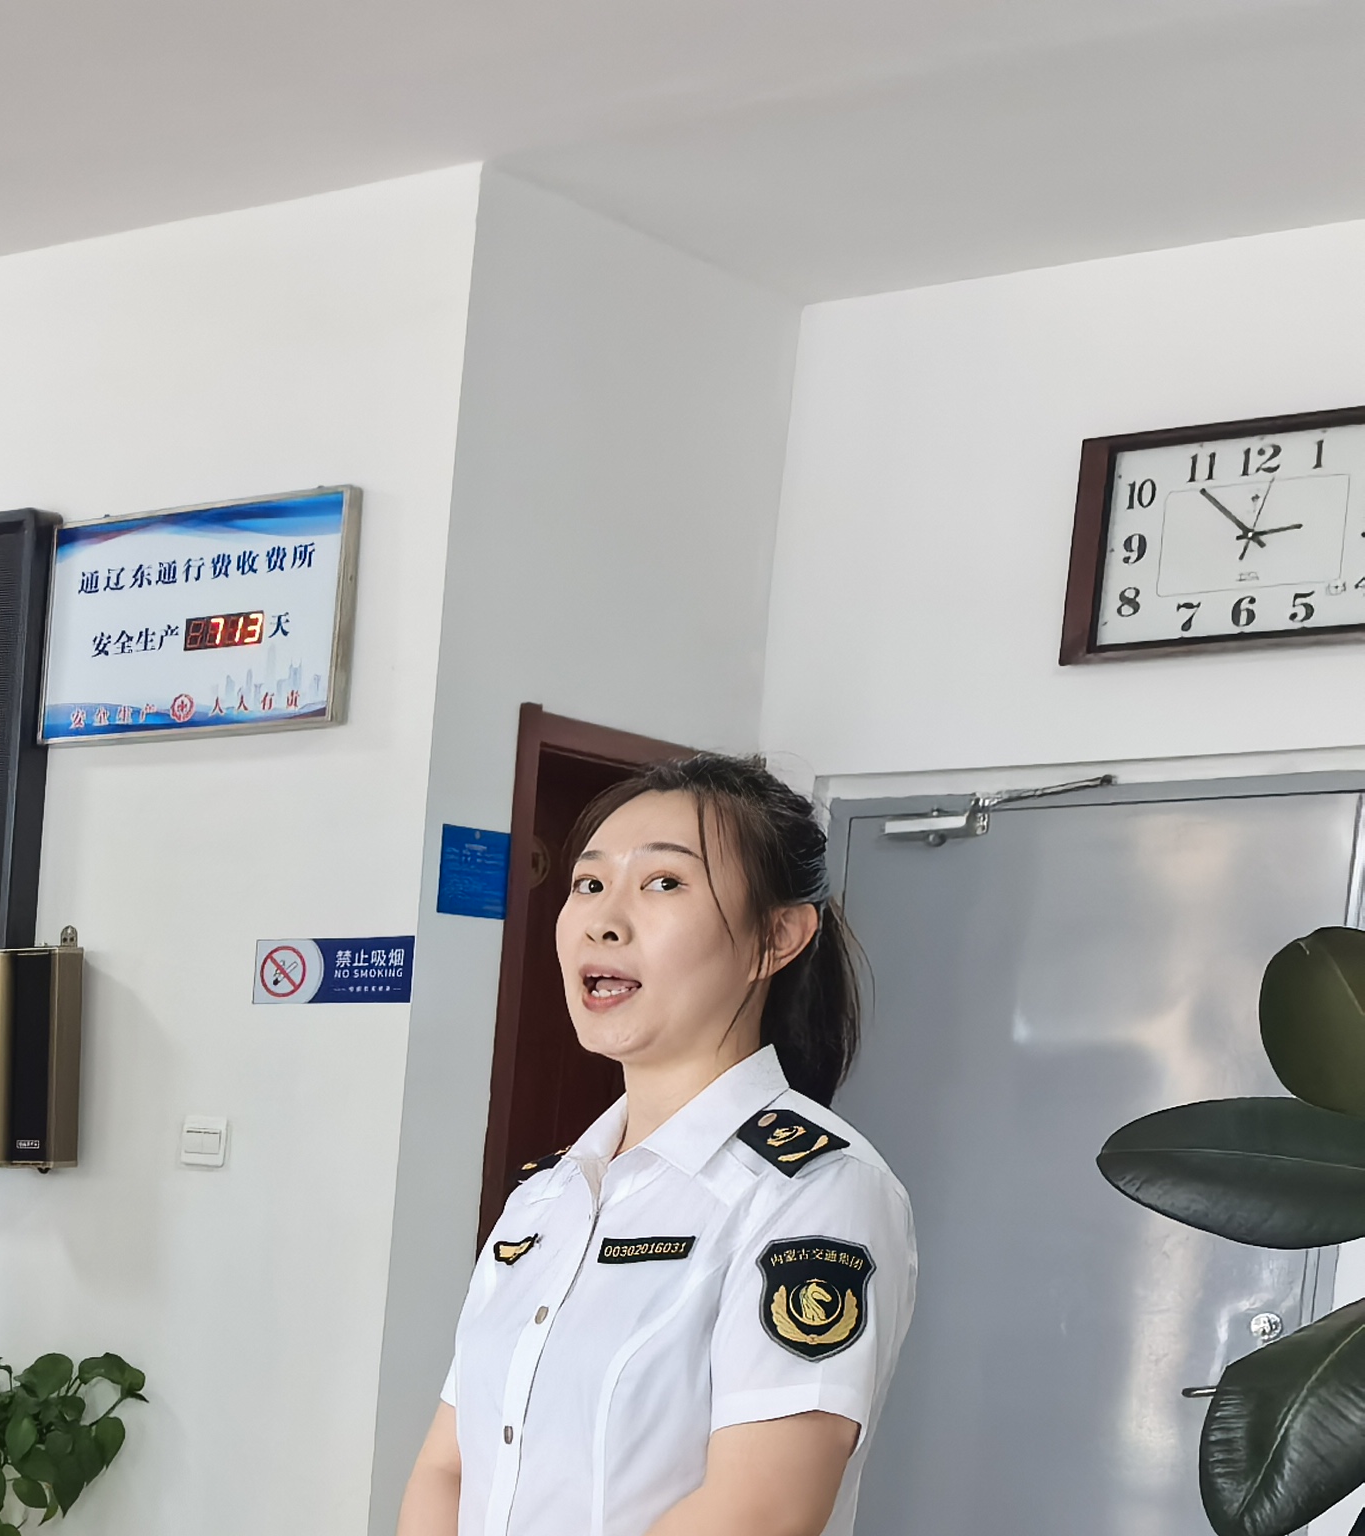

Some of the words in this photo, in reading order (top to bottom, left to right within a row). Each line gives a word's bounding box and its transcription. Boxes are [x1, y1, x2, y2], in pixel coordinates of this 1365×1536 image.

[1187, 452, 1216, 482] 11
[1240, 444, 1282, 476] 12
[1312, 439, 1324, 469] 1
[1126, 478, 1157, 510] 10
[1122, 533, 1147, 564] 9
[78, 542, 316, 595] 通辽东通行费收费所
[1117, 587, 1141, 617] 8
[1176, 601, 1201, 632] 7
[1231, 596, 1256, 627] 6
[1289, 590, 1315, 622] 5
[91, 624, 179, 658] 安全生产
[268, 612, 290, 638] 天
[70, 703, 157, 729] 安全生产
[211, 690, 300, 715] 人人有责
[334, 968, 350, 978] NO
[353, 968, 403, 978] SMOKING
[335, 948, 405, 968] 禁止吸烟
[604, 1242, 686, 1257] 00302016031
[770, 1248, 863, 1271] 内蒙古交通集团
